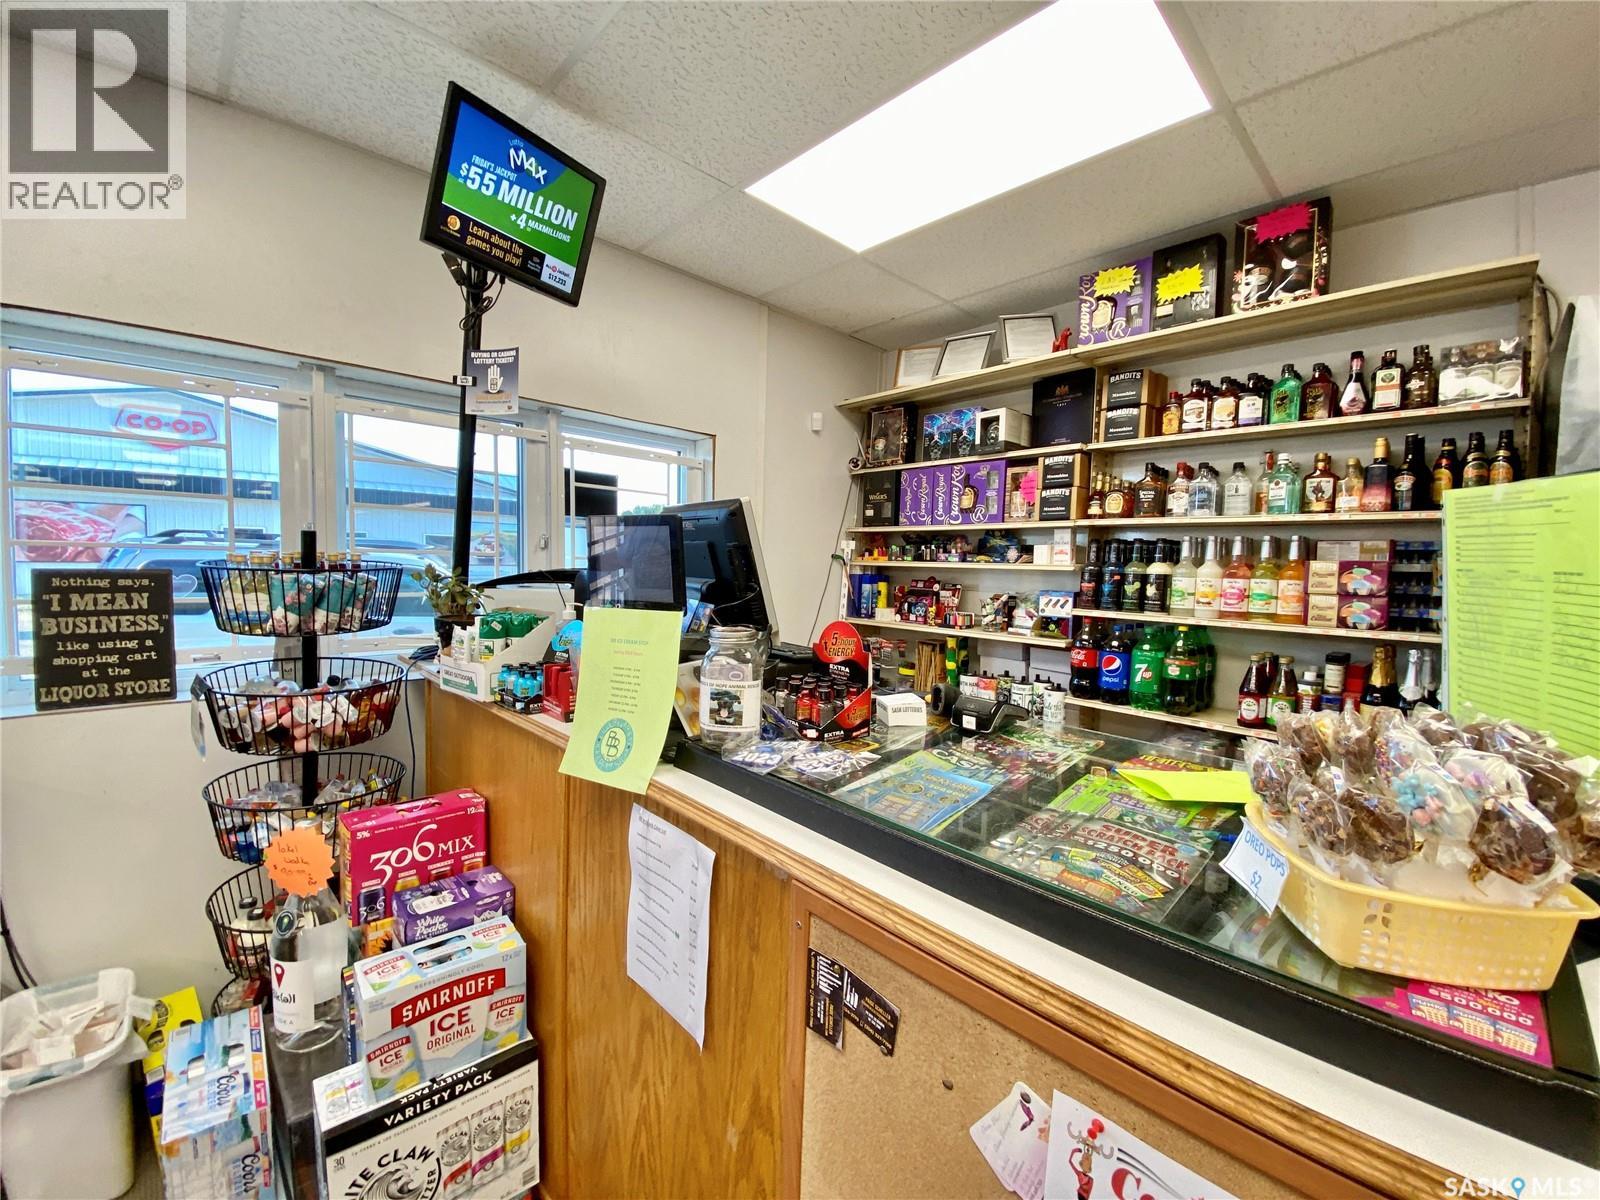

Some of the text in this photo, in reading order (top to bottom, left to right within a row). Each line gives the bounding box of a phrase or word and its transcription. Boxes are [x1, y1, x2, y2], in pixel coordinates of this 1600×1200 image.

[471, 154, 518, 181] FRIDAY'S JACKPOT
[509, 147, 548, 185] MAX
[459, 162, 579, 231] $55 MILLION
[510, 214, 571, 243] +4 MAXMILLIONS
[469, 222, 490, 239] Learn
[491, 233, 511, 249] about
[512, 242, 524, 256] the
[466, 235, 490, 252] games
[492, 248, 504, 260] you
[505, 254, 522, 267] play!
[1110, 371, 1142, 384] BANDITS
[1106, 407, 1139, 418] BANDITS
[126, 413, 207, 435] CO-OP
[1044, 455, 1073, 466] BANDITS
[1041, 488, 1071, 498] BANDITS
[52, 577, 111, 588] Nothing
[69, 592, 150, 612] MEAN
[40, 614, 169, 636] BUSINESS,"
[56, 639, 154, 651] like using a
[828, 646, 855, 657] ENERGY
[52, 651, 158, 666] shopping cart
[829, 663, 850, 672] EXTRA
[82, 666, 131, 678] at the
[39, 678, 171, 704] LIQUOR STORE
[824, 730, 845, 738] EXTRA
[734, 752, 783, 765] 2023
[1080, 826, 1143, 853] SCRATCH
[369, 823, 438, 886] 306
[438, 835, 476, 858] MIX
[1244, 830, 1286, 878] OREO POPS
[1250, 869, 1262, 889] $2
[416, 915, 446, 928] White
[416, 922, 449, 936] Peaks
[482, 930, 502, 939] ICE
[377, 963, 400, 977] ICE
[401, 974, 496, 1022] SMIRNOFF
[489, 995, 524, 1012] SMIRNOFF
[428, 1005, 472, 1037] ICE
[495, 1005, 515, 1020] ICE
[426, 1024, 476, 1051] ORIGINAL
[369, 1036, 411, 1061] SMIRNOFF
[379, 1051, 403, 1068] ICE
[216, 1074, 237, 1107] Coors
[399, 1066, 479, 1105] VARIETY PACK
[383, 1069, 493, 1128] VARIETY PACK
[332, 1157, 345, 1168] 30
[377, 1145, 436, 1169] CLAW
[241, 1153, 261, 1194] Coors
